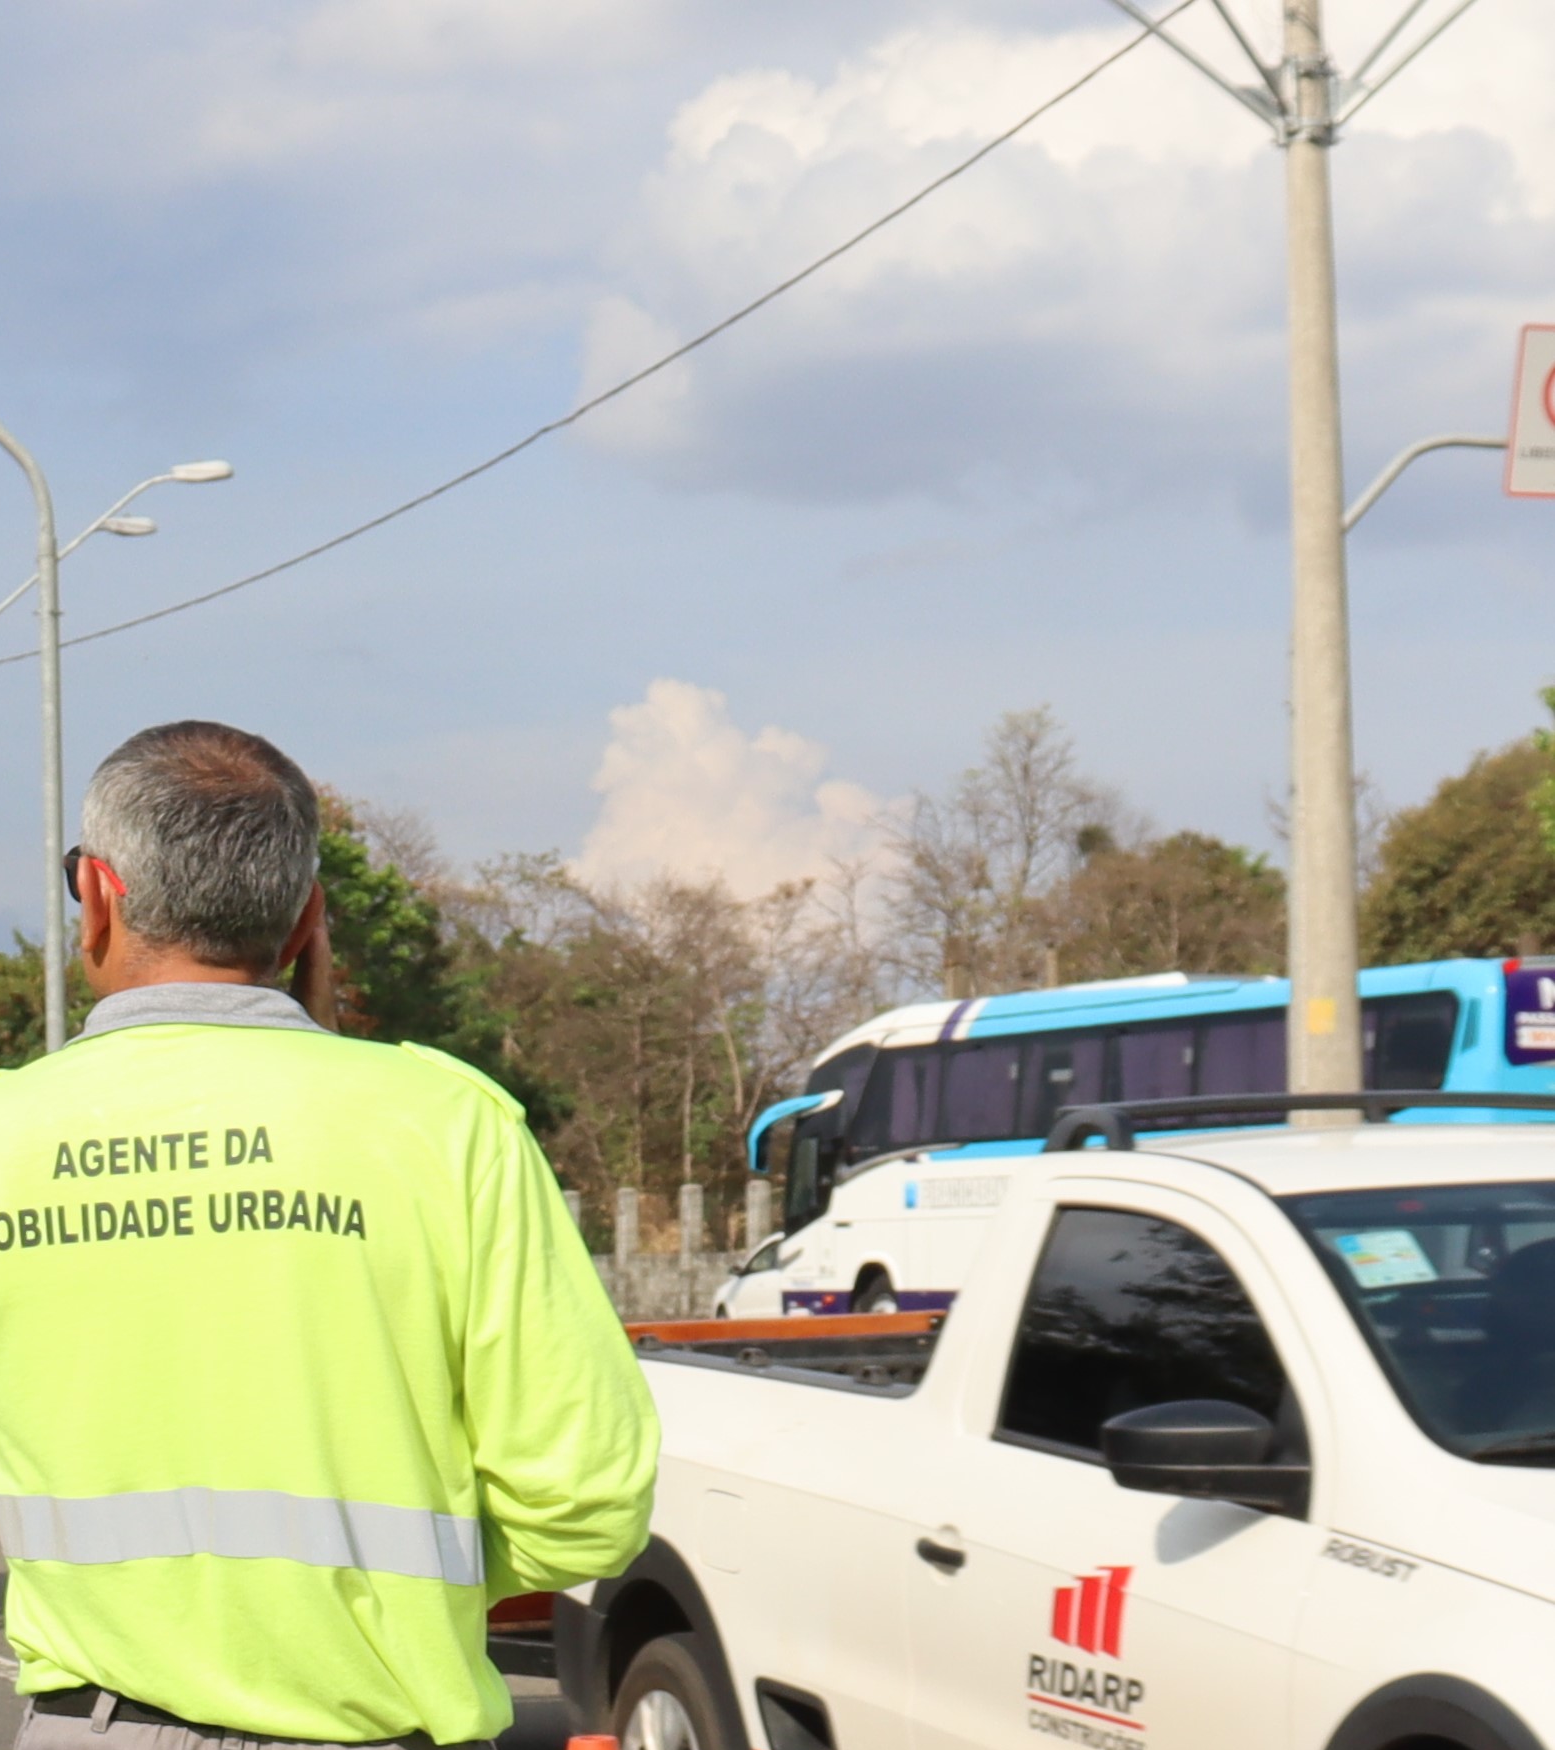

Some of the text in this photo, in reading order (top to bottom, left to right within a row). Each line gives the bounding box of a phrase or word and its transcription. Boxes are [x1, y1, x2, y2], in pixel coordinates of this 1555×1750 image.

[53, 1126, 273, 1180] AGENTE DA
[208, 1189, 367, 1241] URBANA
[1321, 1538, 1420, 1582] ROBUST
[1027, 1653, 1146, 1714] RIDARP
